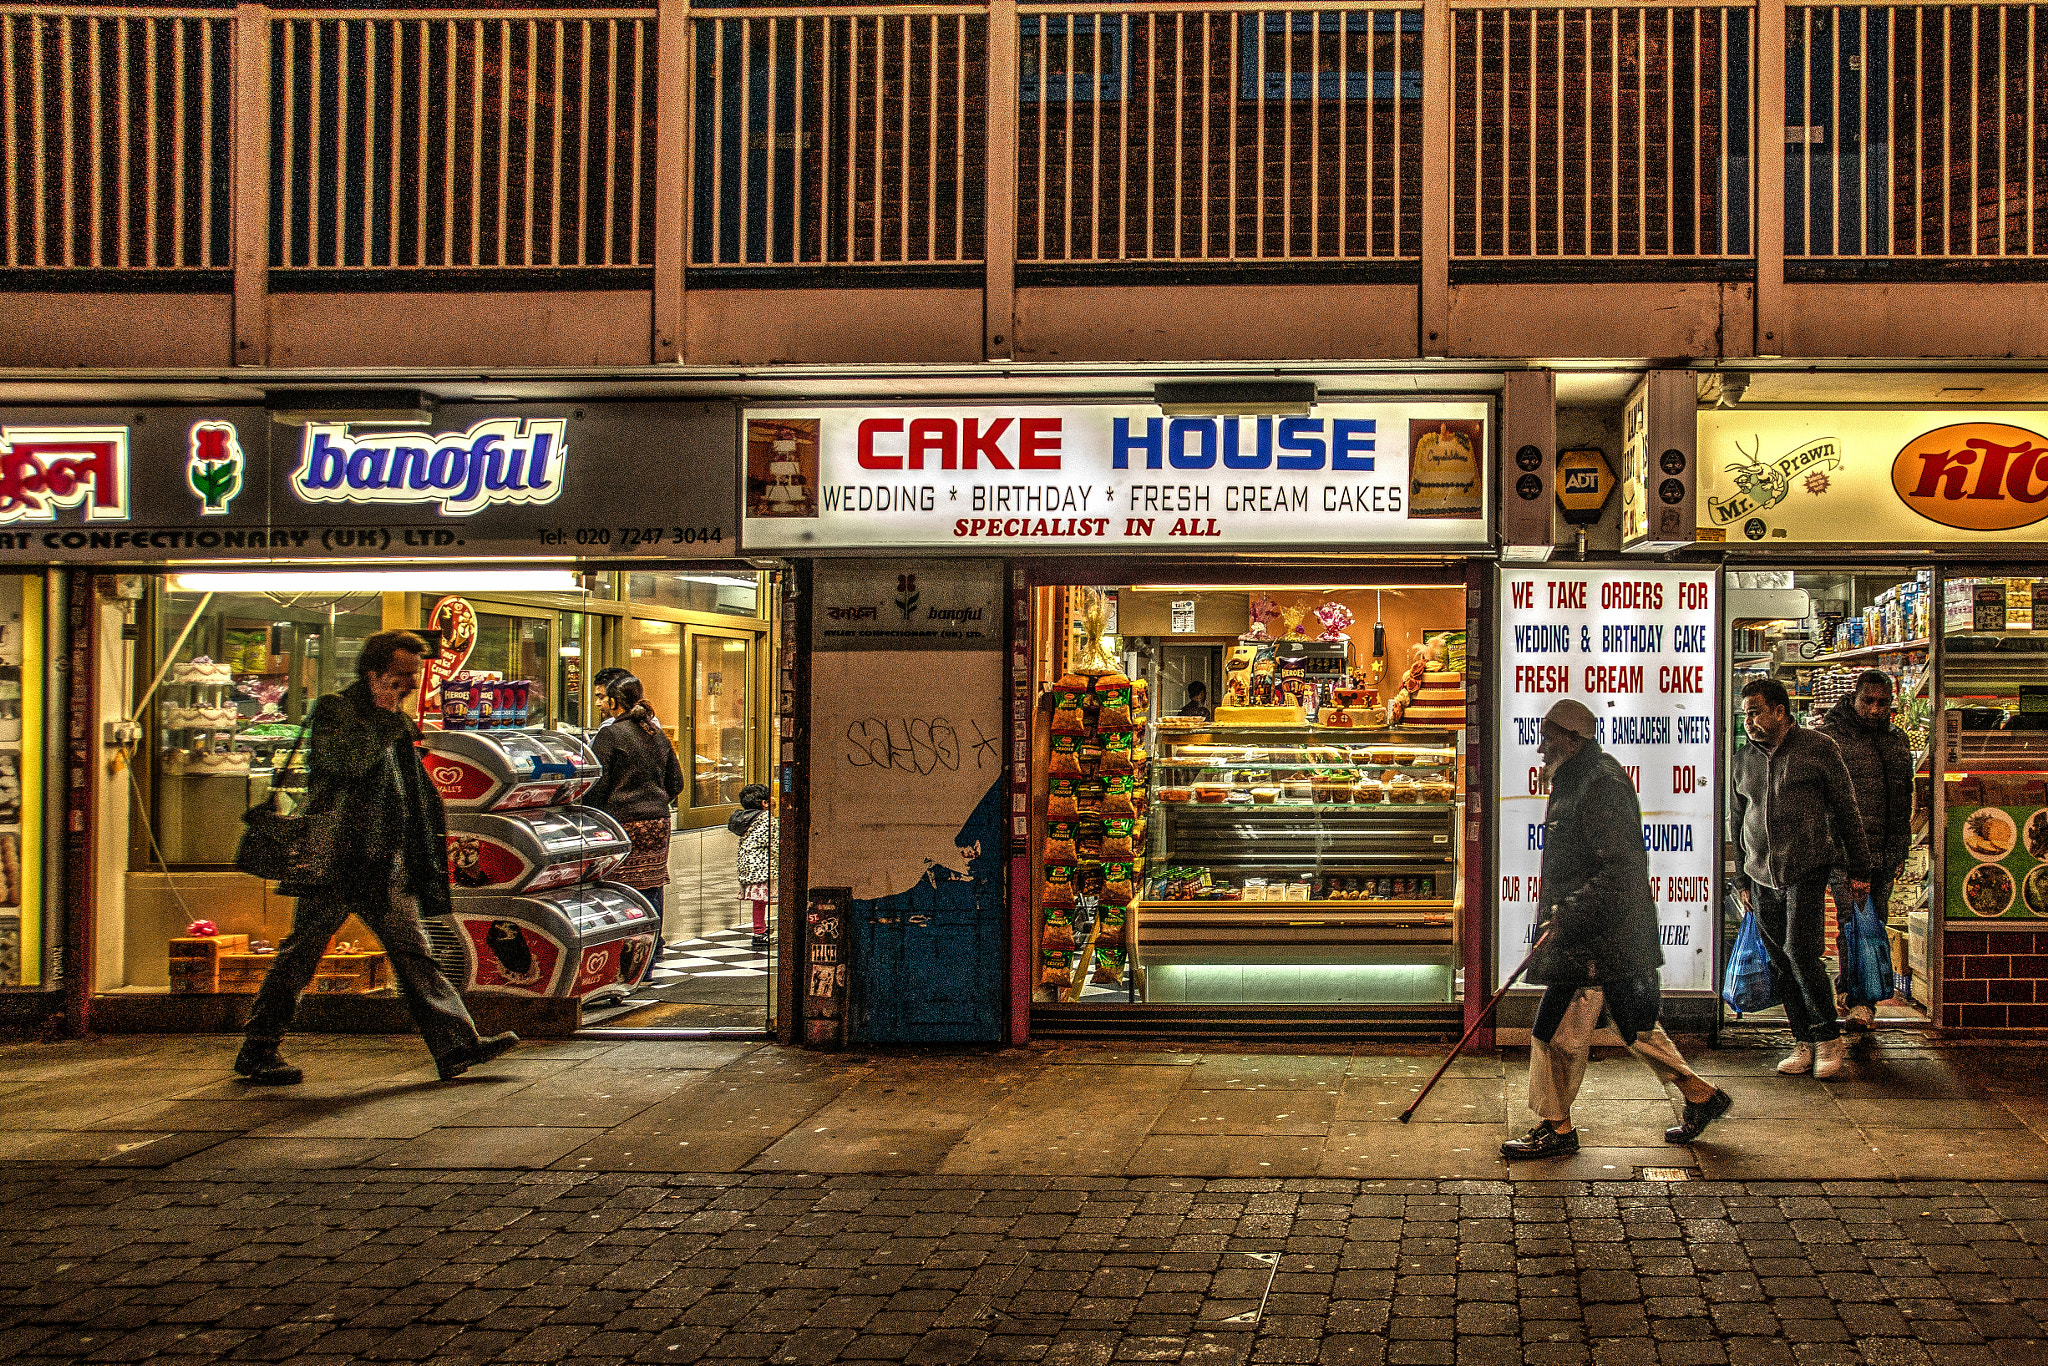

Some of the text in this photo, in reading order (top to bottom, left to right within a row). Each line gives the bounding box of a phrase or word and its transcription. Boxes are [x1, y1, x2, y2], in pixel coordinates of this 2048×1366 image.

[857, 416, 1376, 471] CAKE HOUSE
[301, 433, 553, 501] banoful
[1566, 473, 1599, 489] ADT
[1717, 443, 1835, 521] Mr. Prawn
[823, 485, 1401, 512] WEDDING BIRTHDAY FRESH CREAM CAKES
[43, 531, 309, 548] CONFECTIONARY
[321, 528, 391, 550] (UK)
[404, 530, 465, 547] LTD.
[538, 527, 722, 545] Tel: 020 7247 3044
[953, 517, 1221, 537] SPECIALIST IN ALL
[1511, 581, 1708, 610] WE TAKE ORDERS FOR
[928, 607, 982, 622] banoful
[1515, 625, 1706, 652] WEDDING & BIRTHDAY CAKE
[1281, 668, 1305, 678] HEROES
[1515, 665, 1703, 693] FRESH CREAM CAKE
[444, 691, 470, 700] HEROES
[1612, 716, 1670, 744] BANGLADESHI
[1678, 716, 1710, 744] SWEETS
[1673, 765, 1696, 794] DOI
[1643, 824, 1693, 851] BUNDIA
[1502, 876, 1520, 902] OUR
[1668, 877, 1709, 902] BISCUITS
[1659, 925, 1690, 946] HERE
